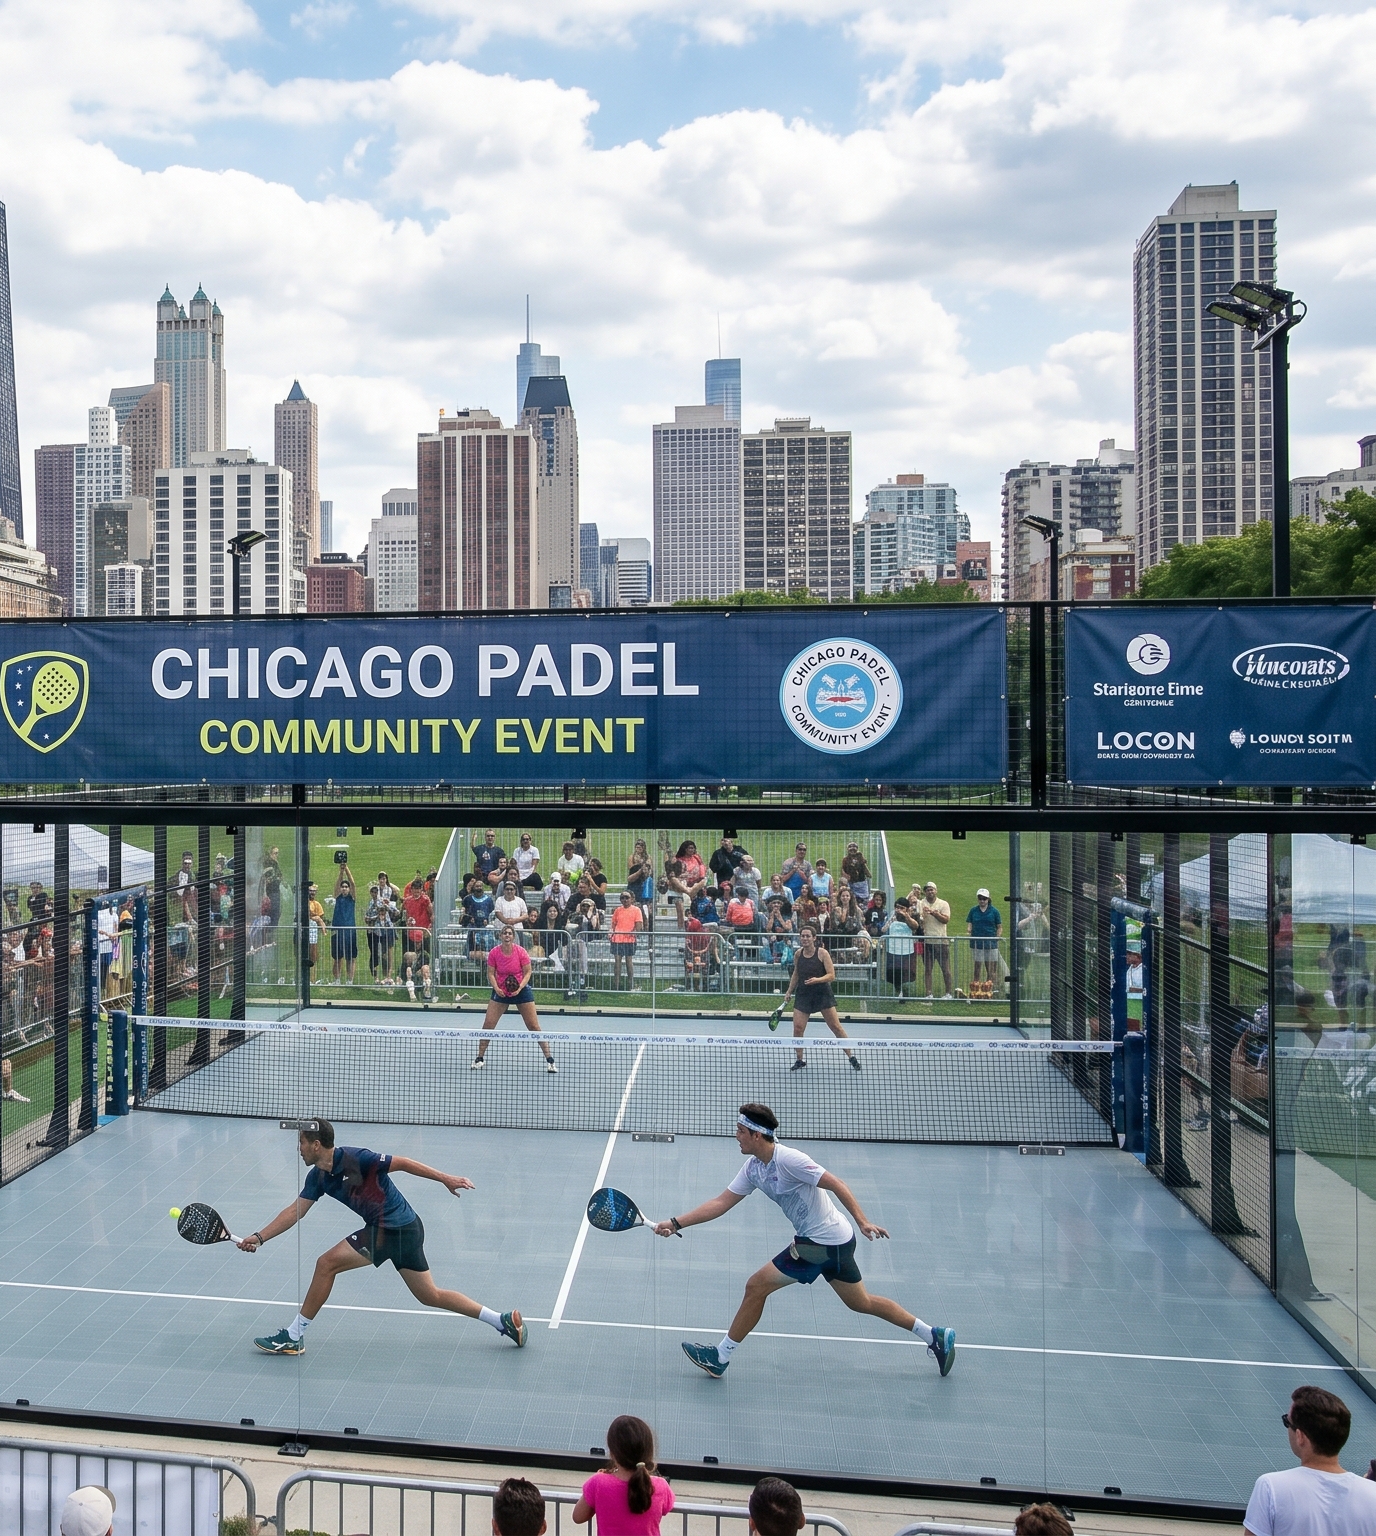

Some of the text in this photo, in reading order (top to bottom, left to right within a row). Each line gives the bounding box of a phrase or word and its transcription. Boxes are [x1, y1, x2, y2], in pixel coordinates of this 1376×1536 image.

[151, 642, 700, 699] CHICAGO PADEL
[792, 646, 890, 687] CHICAGO PADEL
[199, 717, 644, 755] COMMUNITY EVENT
[791, 704, 858, 745] COMMUNITY
